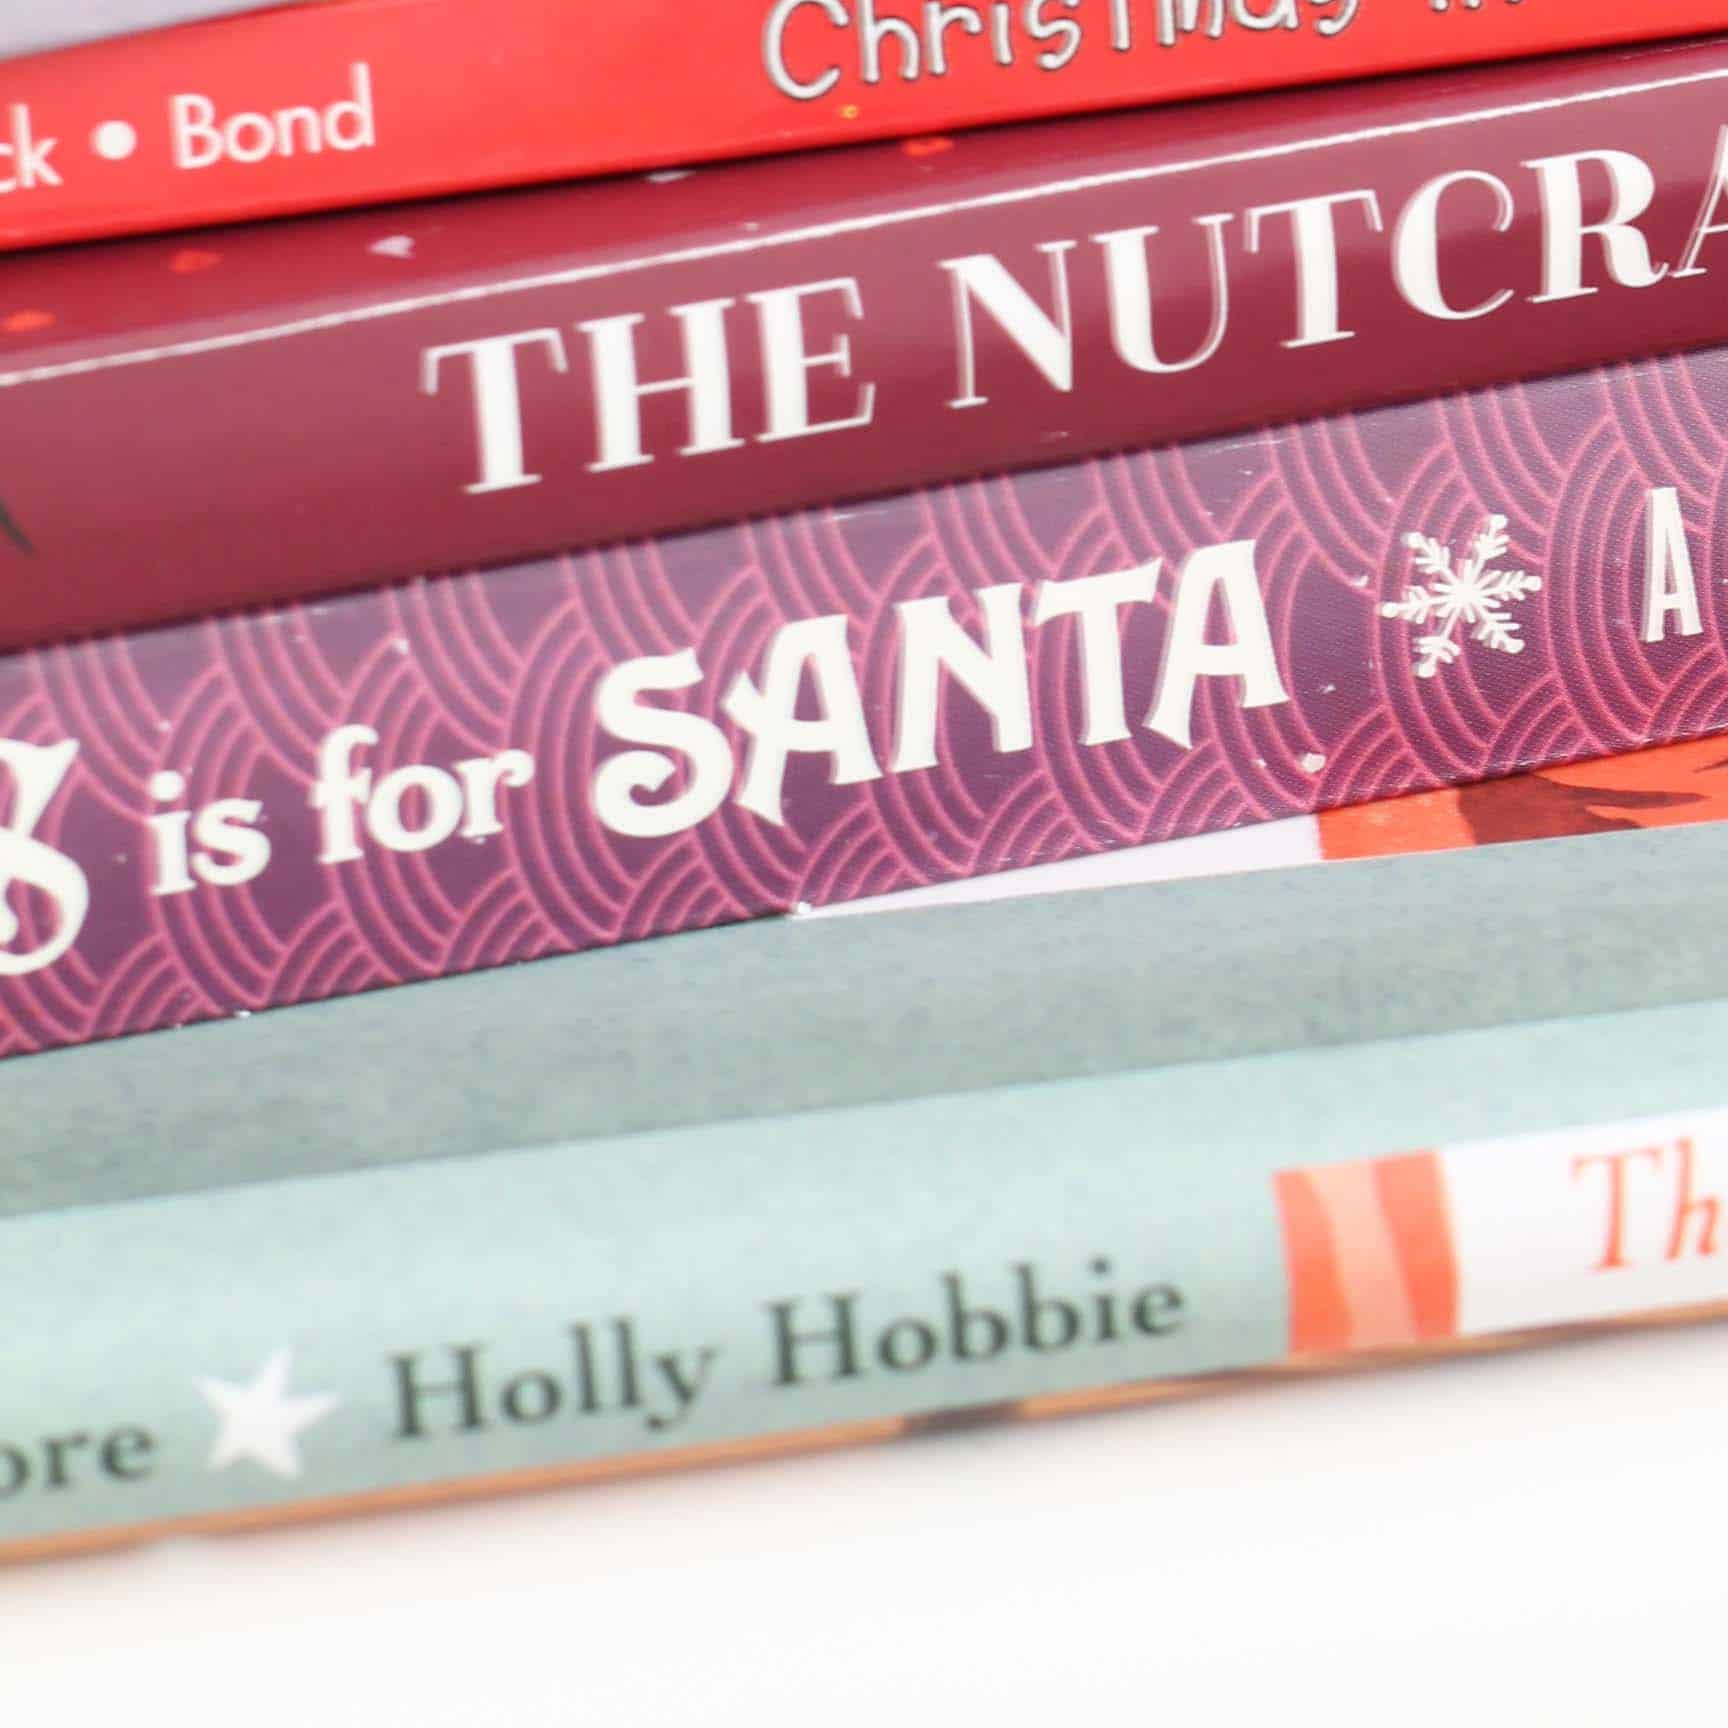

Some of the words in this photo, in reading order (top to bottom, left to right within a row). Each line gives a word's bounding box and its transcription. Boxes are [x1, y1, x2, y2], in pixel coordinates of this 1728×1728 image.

[168, 60, 376, 170] Bond
[419, 276, 876, 496] THE
[1640, 485, 1704, 644] A
[146, 769, 272, 896] is
[310, 723, 535, 865] for
[592, 539, 1290, 838] SANTA
[387, 1315, 722, 1443] Holly
[762, 1255, 1186, 1388] Hobbie
